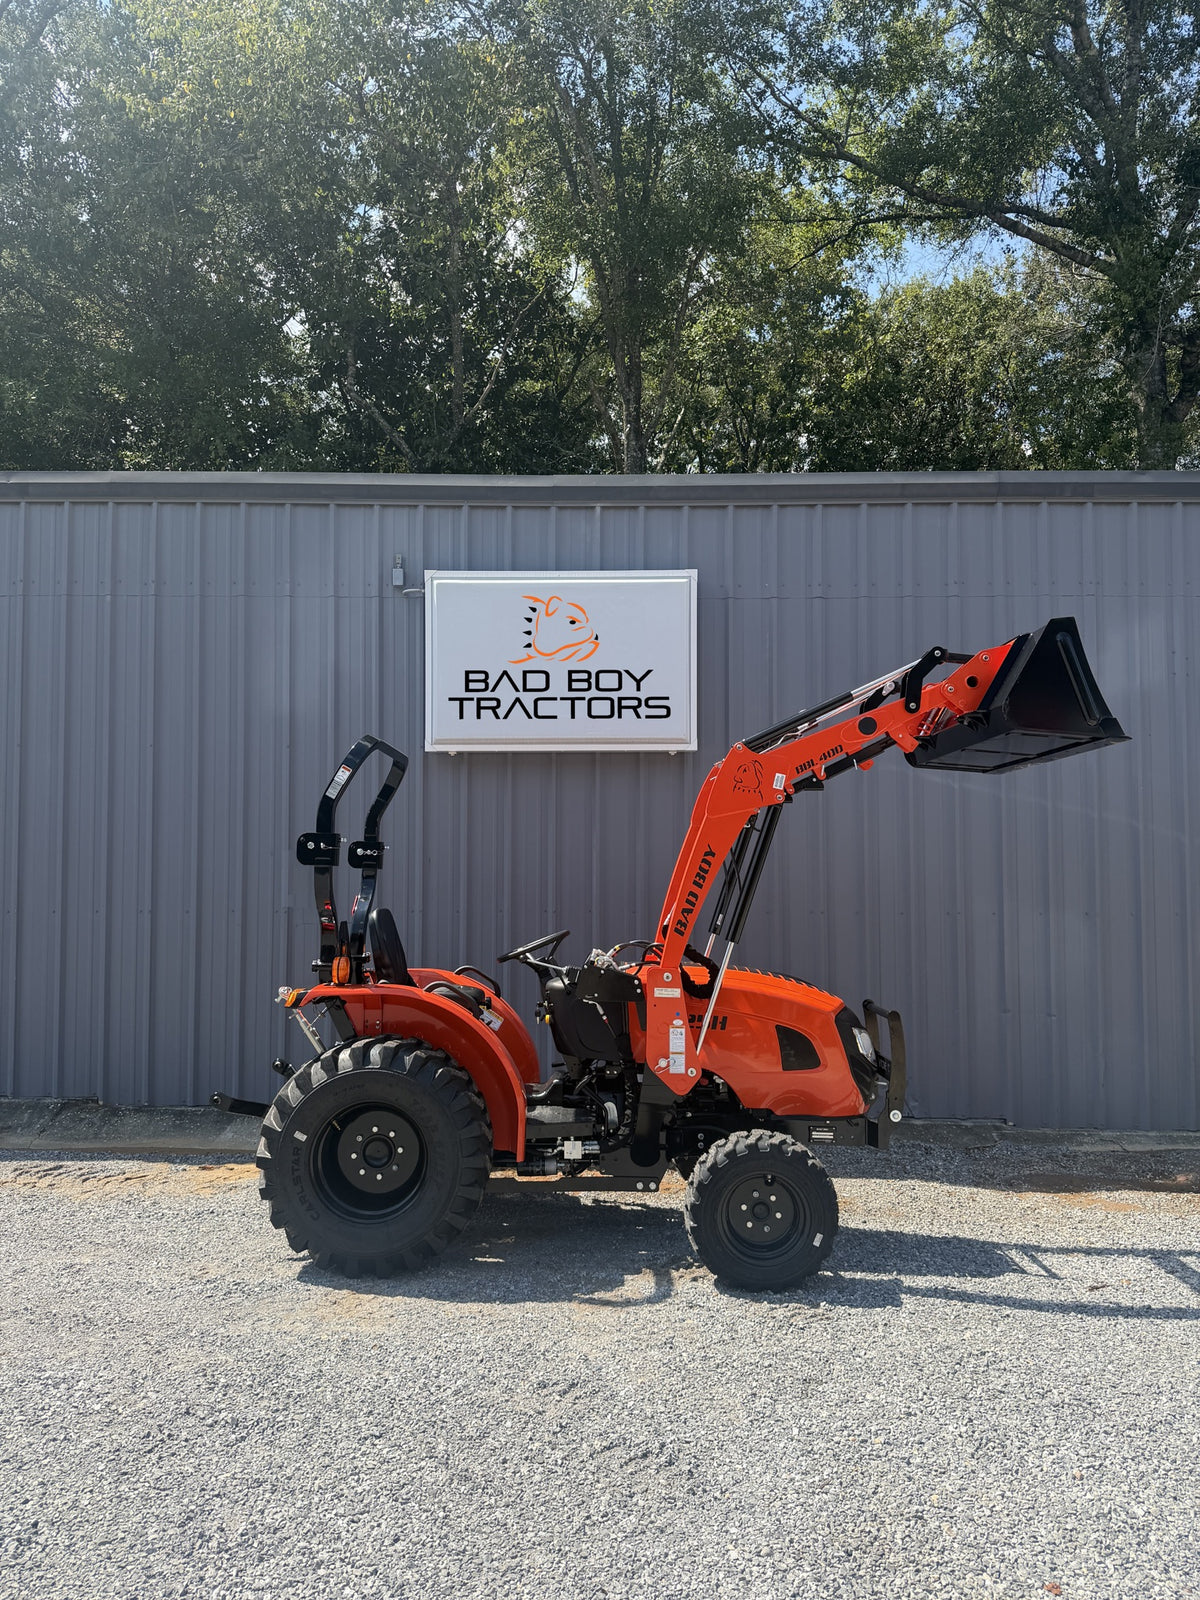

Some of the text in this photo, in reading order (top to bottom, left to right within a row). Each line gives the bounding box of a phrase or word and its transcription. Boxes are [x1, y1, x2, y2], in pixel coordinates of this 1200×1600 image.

[464, 669, 654, 693] BAD BOY
[447, 696, 672, 720] TRACTORS
[819, 744, 844, 761] 400
[673, 843, 716, 937] BAD BOY
